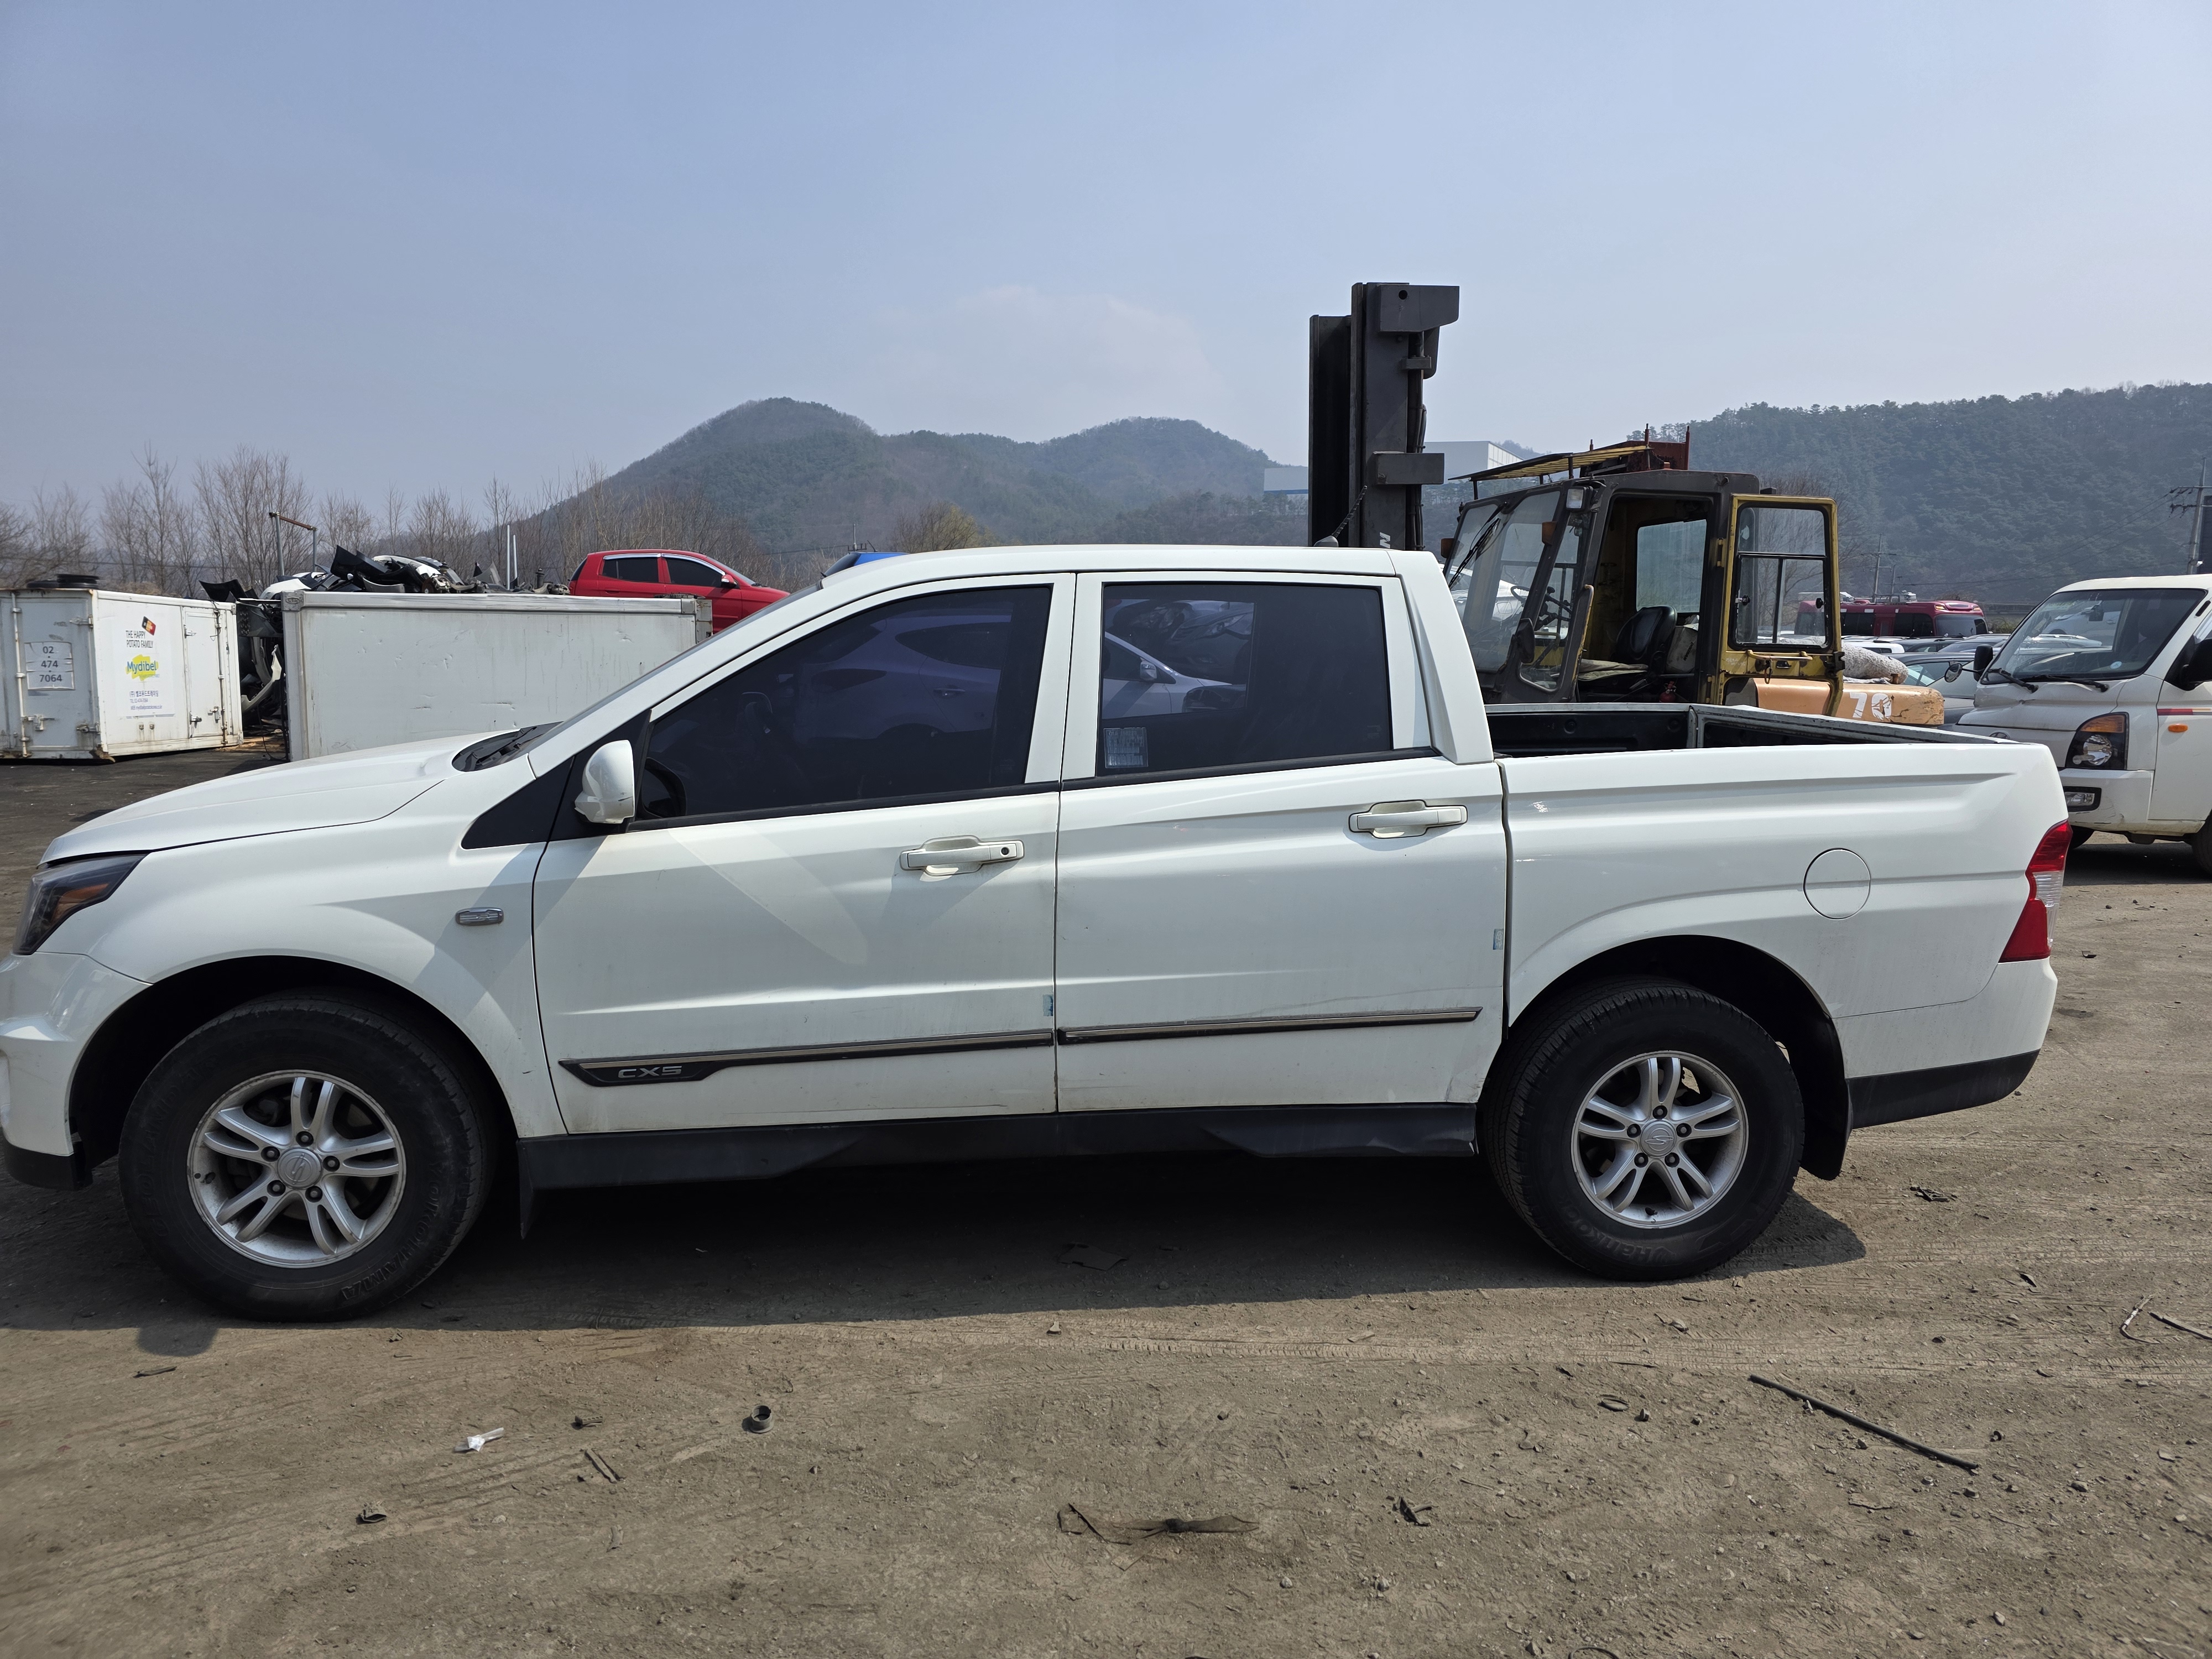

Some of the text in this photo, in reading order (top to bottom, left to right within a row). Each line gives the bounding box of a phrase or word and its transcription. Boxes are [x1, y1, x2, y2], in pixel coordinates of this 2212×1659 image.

[134, 630, 145, 639] HAPPY
[127, 660, 157, 674] Mydibel
[39, 674, 62, 682] 7064
[340, 1161, 444, 1300] YOKOHAMA
